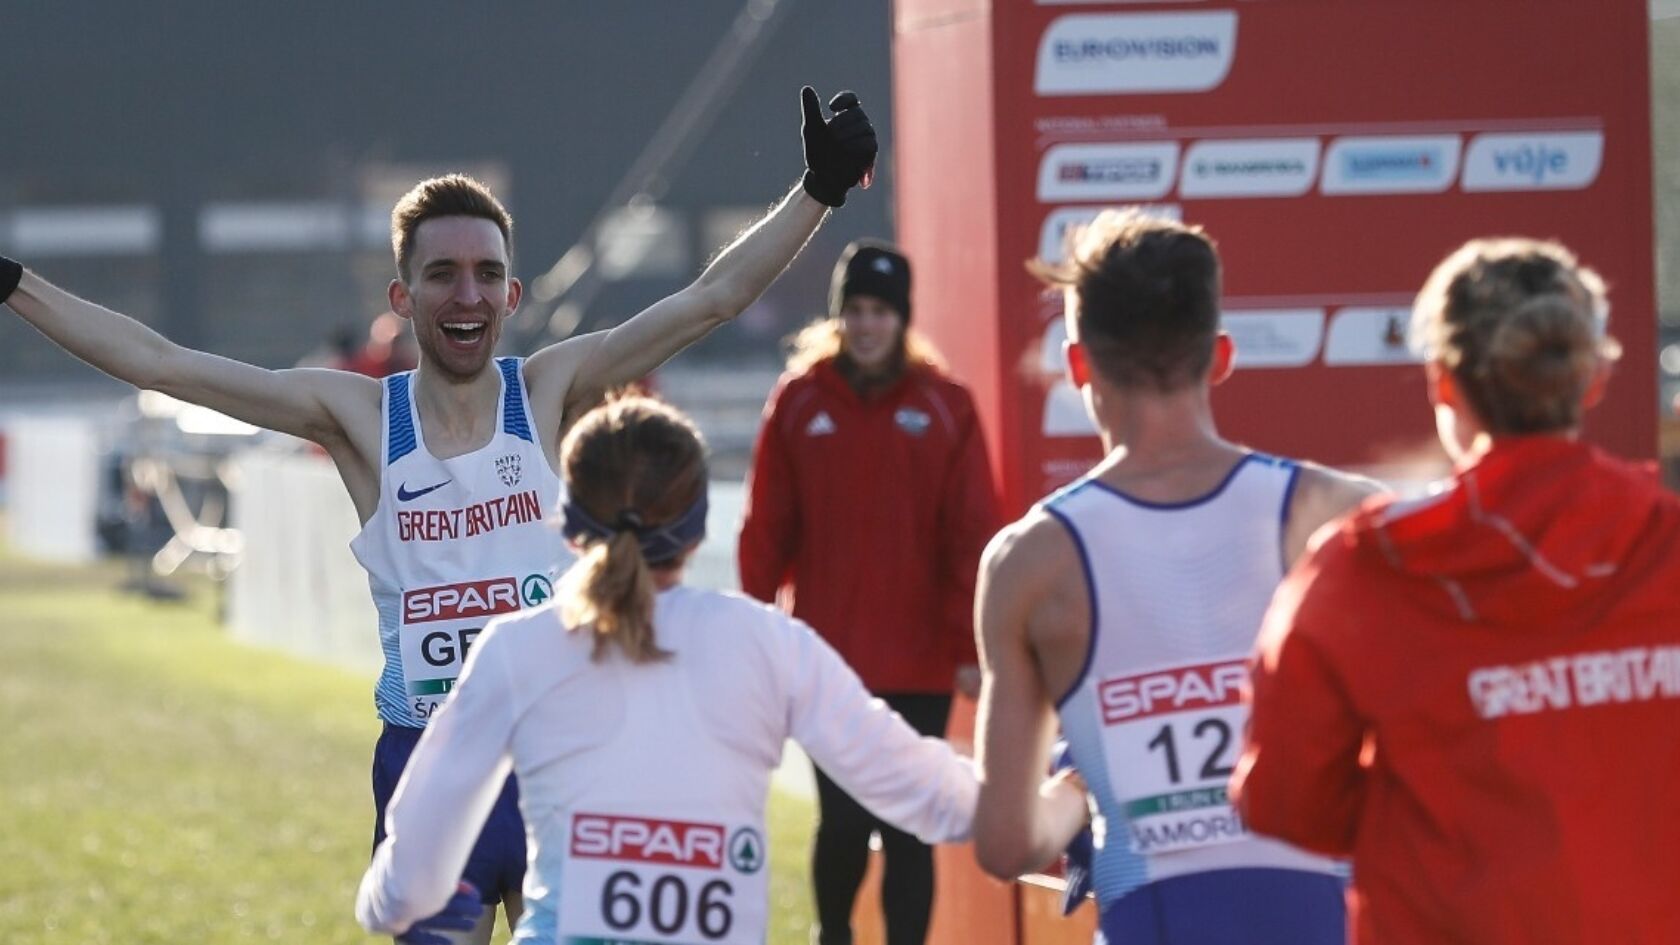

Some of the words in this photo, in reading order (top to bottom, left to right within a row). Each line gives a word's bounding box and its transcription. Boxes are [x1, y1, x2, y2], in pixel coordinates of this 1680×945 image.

[398, 510, 463, 542] GREAT
[465, 490, 542, 537] BRITAIN
[407, 582, 518, 620] SPAR
[1467, 656, 1571, 719] GREAT
[573, 816, 722, 864] SPAR
[601, 869, 735, 940] 606
